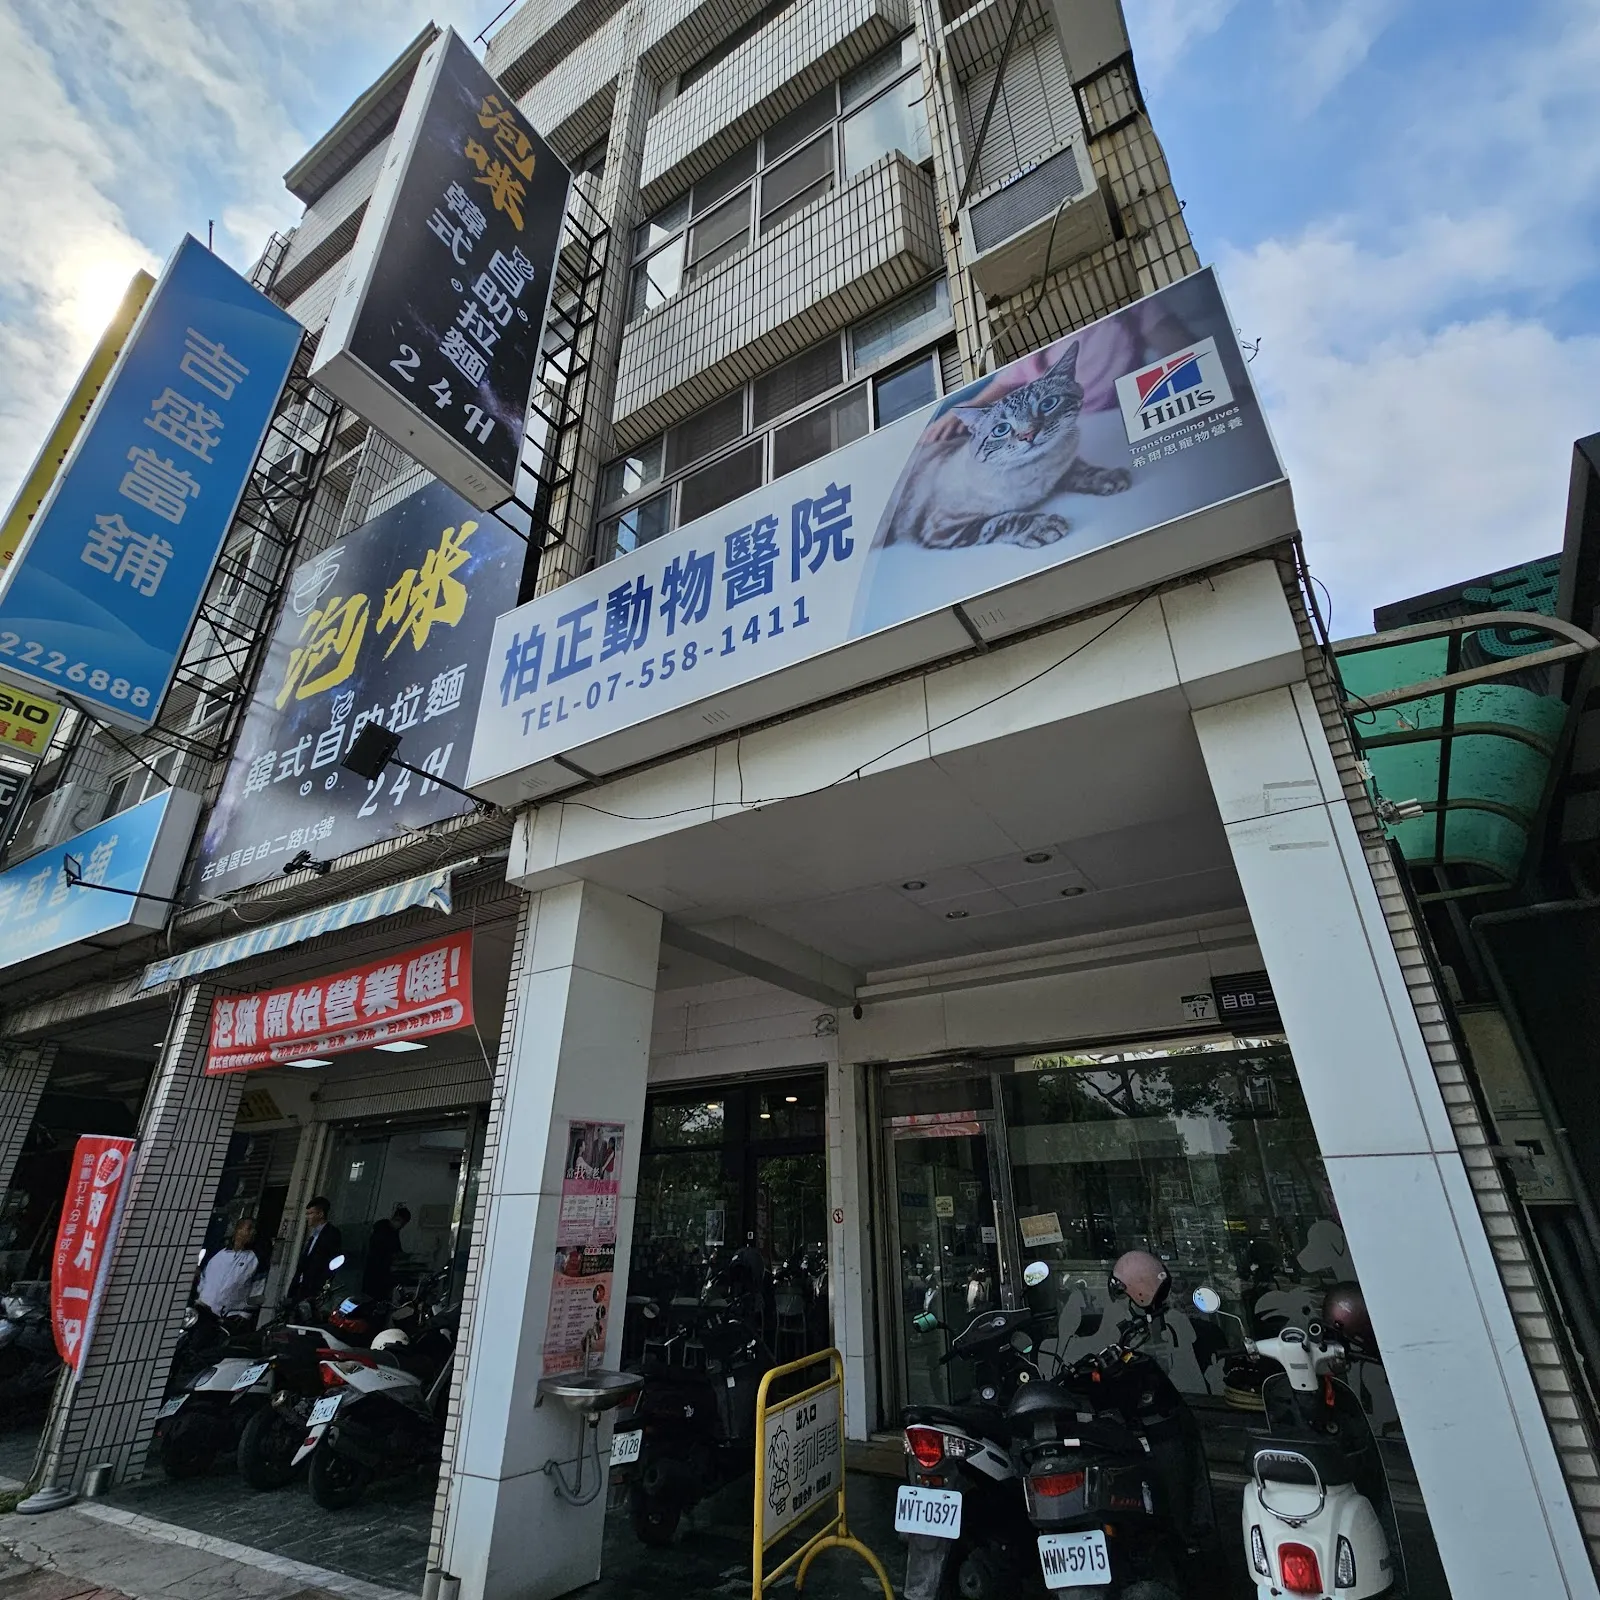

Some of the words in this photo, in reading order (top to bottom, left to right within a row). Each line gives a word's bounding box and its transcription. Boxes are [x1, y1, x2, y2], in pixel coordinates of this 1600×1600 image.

[390, 343, 496, 444] 24H
[1130, 420, 1206, 455] Transforming
[1207, 406, 1240, 424] Lives
[1141, 389, 1216, 431] Hill's
[275, 521, 480, 711] 泡咪
[500, 482, 854, 709] 柏正動物醫院
[521, 596, 811, 737] TEL-07-558-1411
[357, 742, 454, 819] 24H
[1192, 1006, 1206, 1018] 17
[795, 1403, 817, 1432] 出入口
